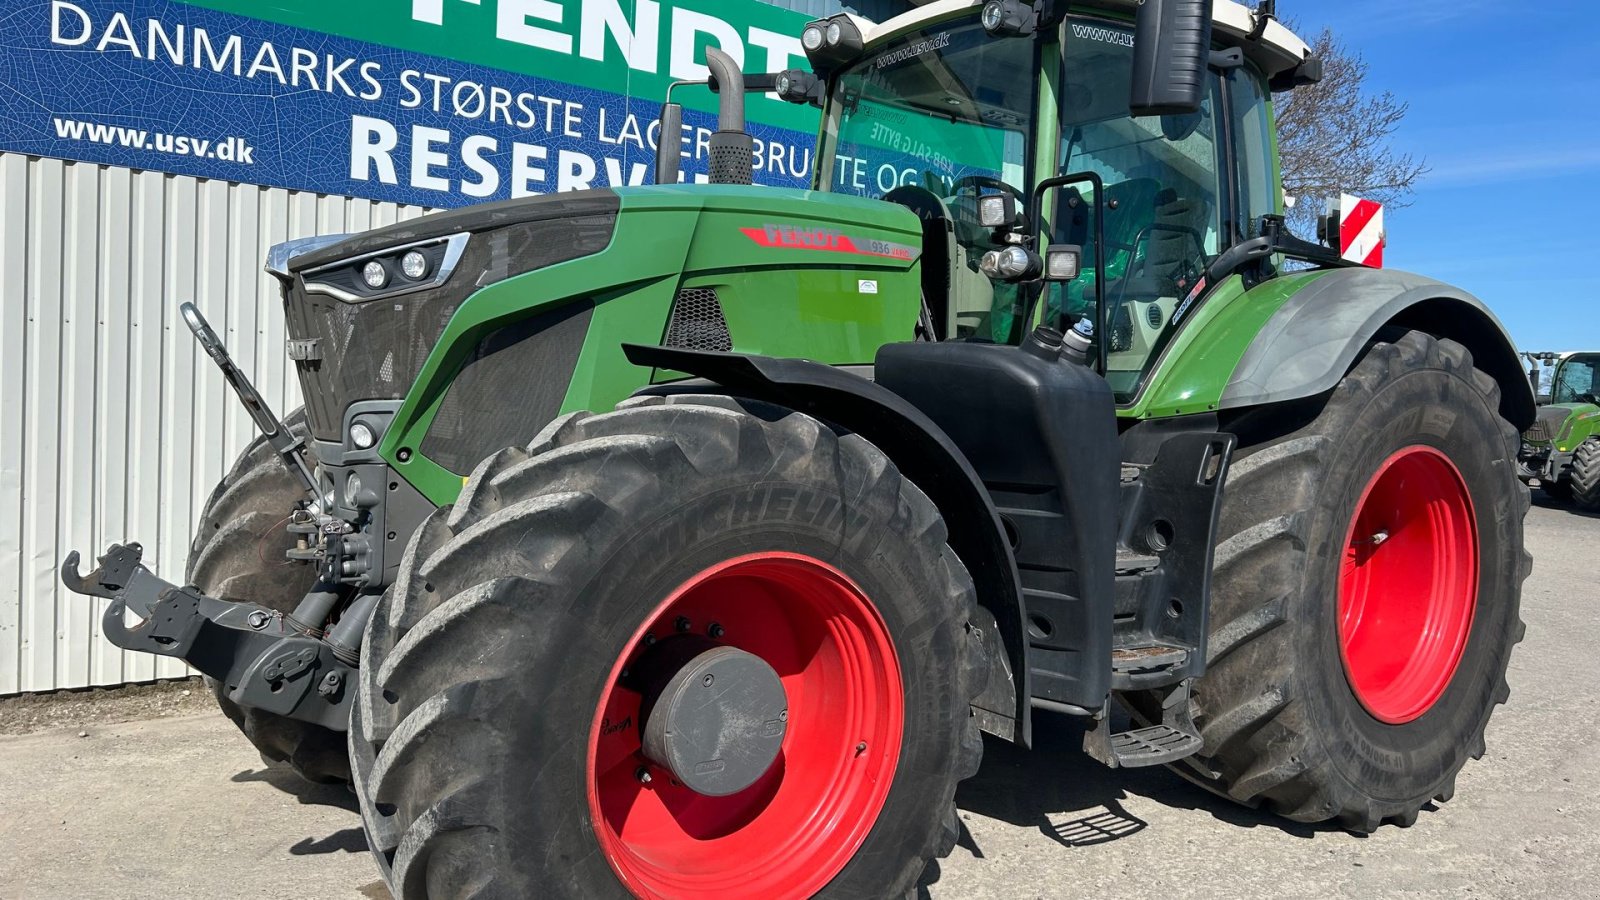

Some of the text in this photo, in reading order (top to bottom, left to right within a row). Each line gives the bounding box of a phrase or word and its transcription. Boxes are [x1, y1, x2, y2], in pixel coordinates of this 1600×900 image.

[876, 31, 951, 69] www.usv.dk
[51, 0, 381, 100] DANMARKS
[400, 69, 583, 137] STØRSTE
[752, 138, 868, 189] BRUTE
[54, 118, 254, 165] www.usv.dk
[350, 114, 710, 200] RESERV
[762, 222, 842, 247] FENDT
[871, 241, 890, 255] 936
